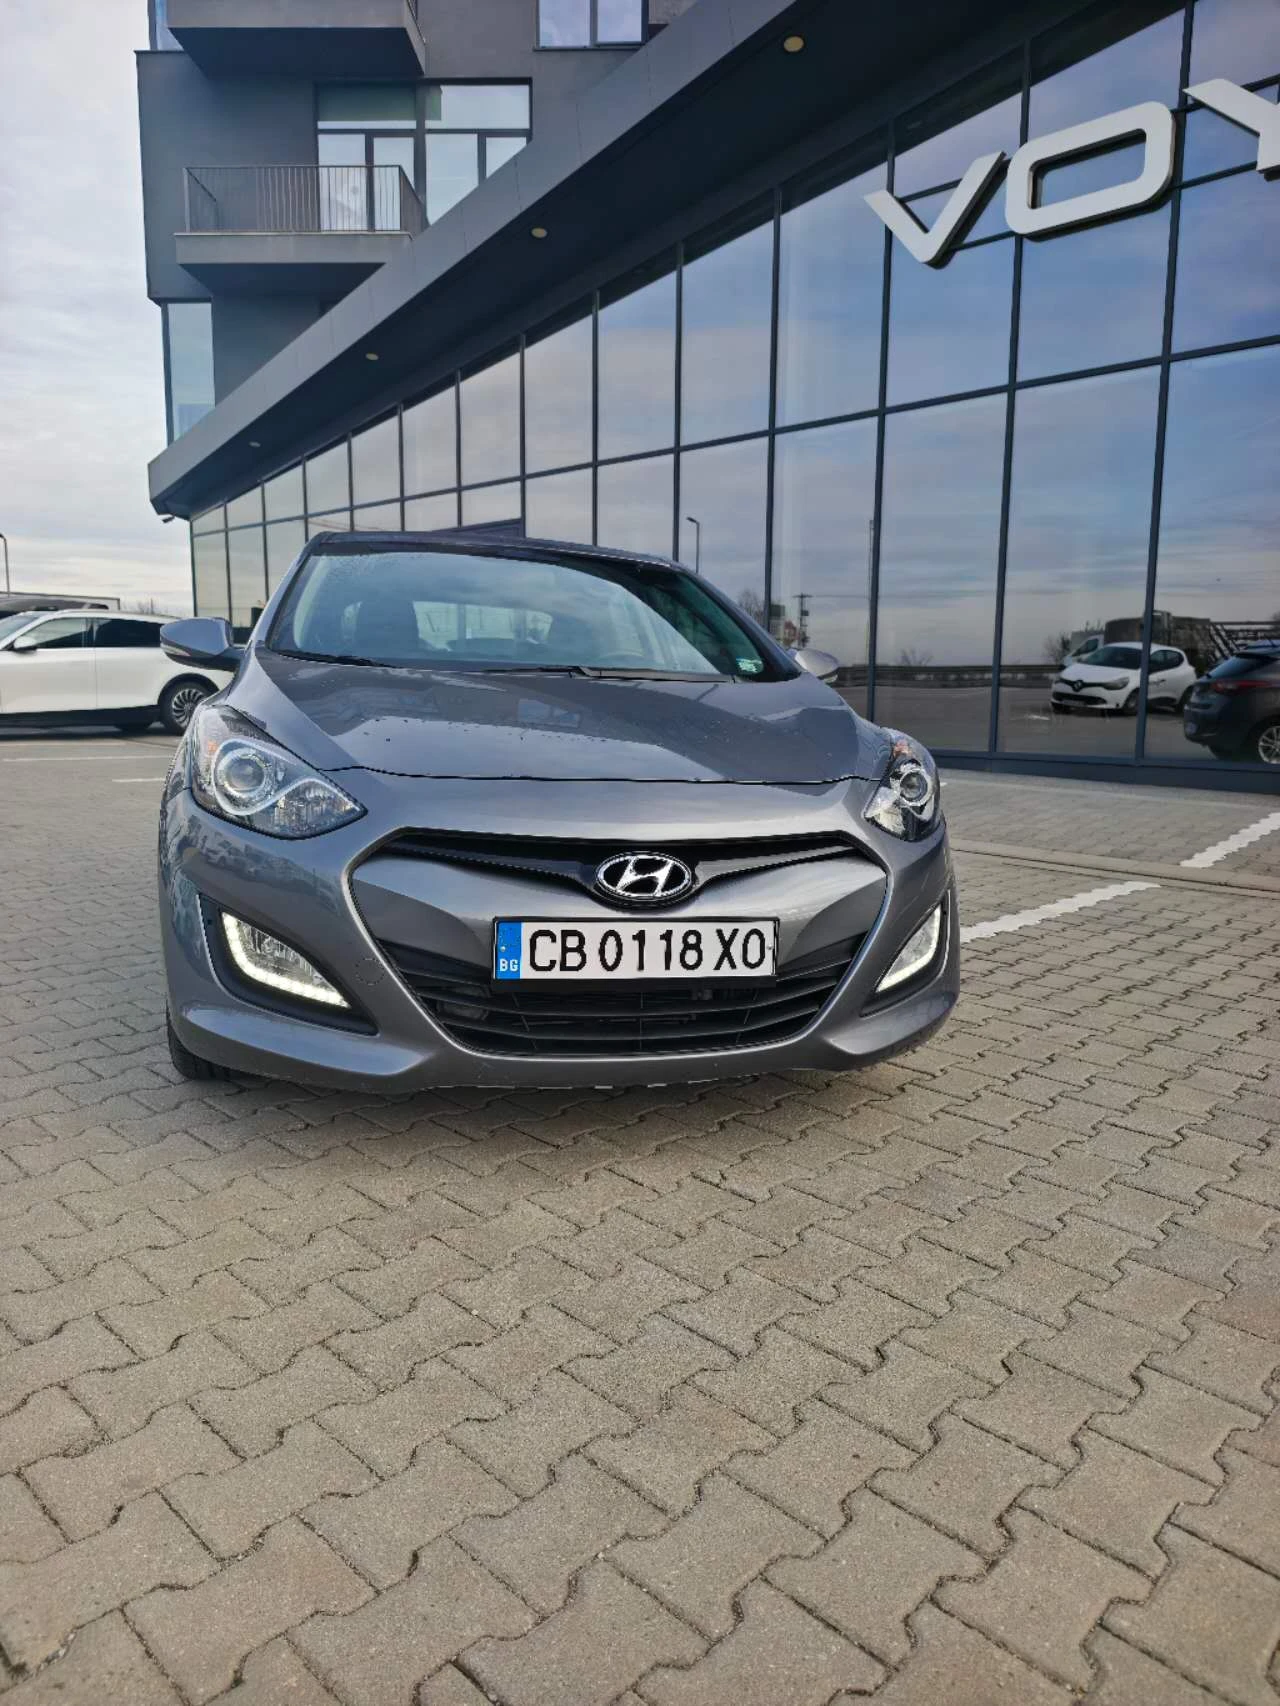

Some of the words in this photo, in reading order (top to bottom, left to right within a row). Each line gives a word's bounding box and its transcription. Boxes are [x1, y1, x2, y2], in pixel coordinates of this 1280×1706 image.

[529, 929, 587, 972] CB
[599, 929, 703, 972] 0118
[499, 958, 519, 972] BG
